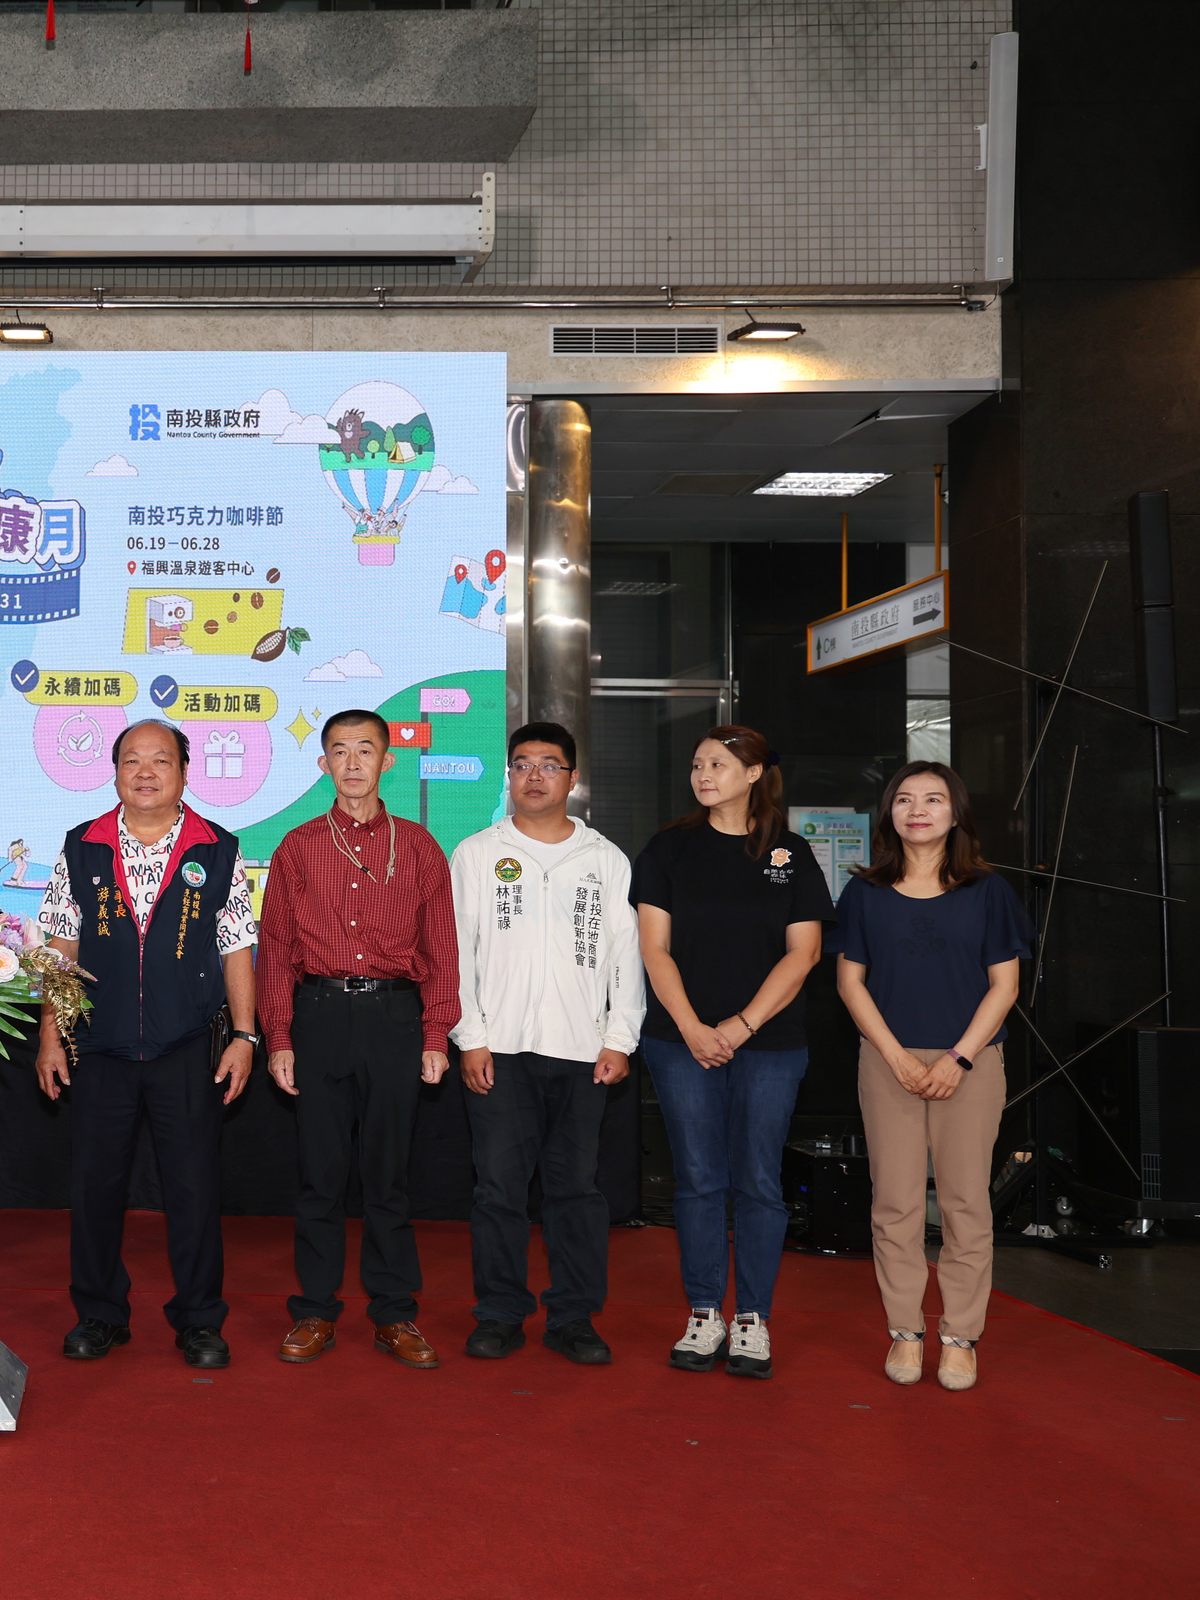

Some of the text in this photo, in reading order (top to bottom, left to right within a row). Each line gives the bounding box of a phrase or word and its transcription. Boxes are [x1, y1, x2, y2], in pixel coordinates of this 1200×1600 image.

[166, 408, 261, 428] 南投縣政府
[193, 431, 216, 439] County
[127, 504, 284, 527] 南投巧克力咖啡節
[141, 559, 256, 577] 福興溫泉遊客中心
[44, 676, 122, 698] 永續加碼
[183, 692, 262, 714] 活動加碼
[432, 695, 456, 707] GO!
[423, 762, 475, 774] NANTOU
[512, 884, 523, 916] 理事長
[96, 886, 111, 937] 游義誠
[573, 886, 589, 967] 發展創新協會
